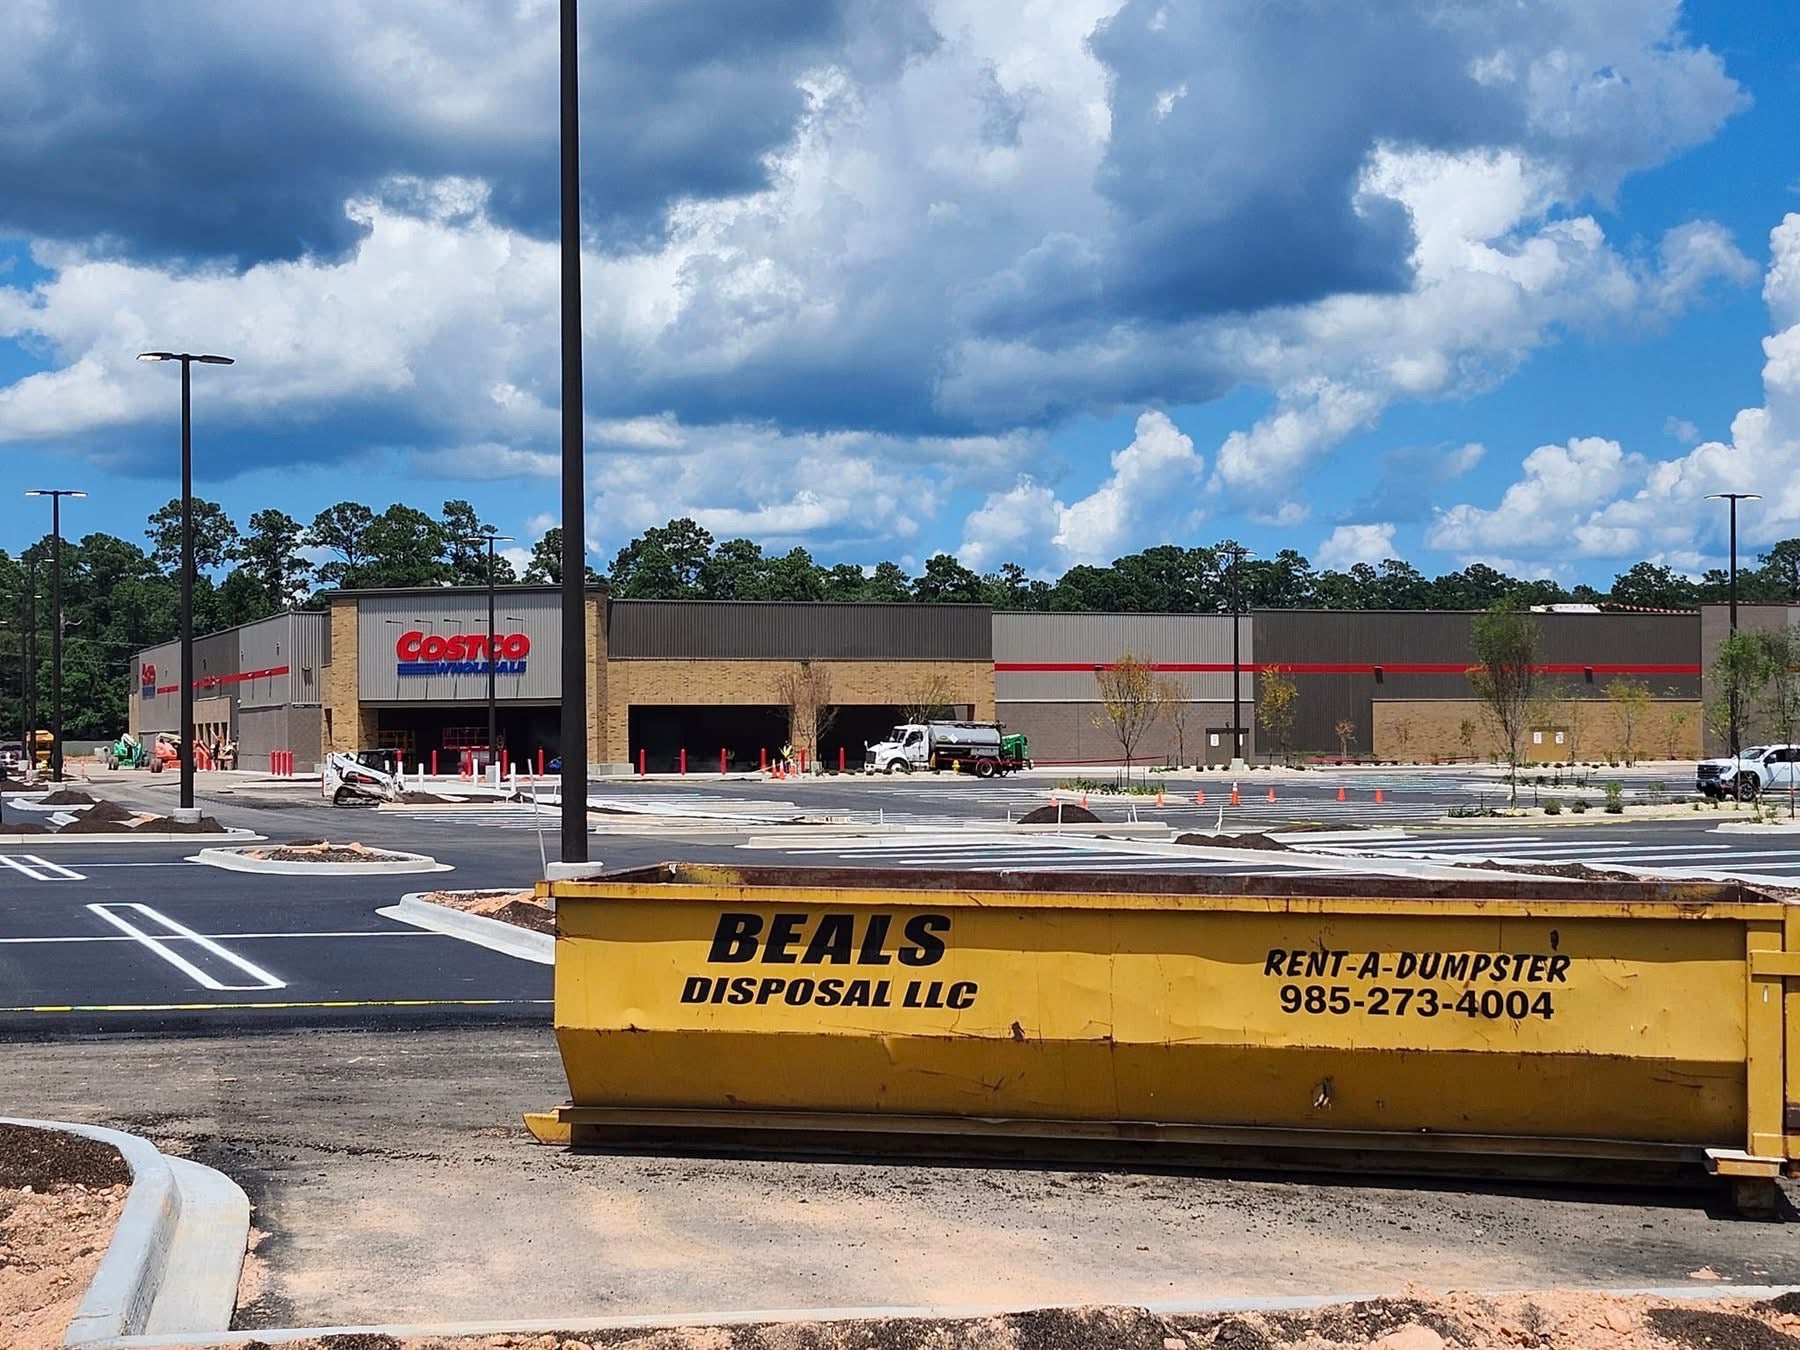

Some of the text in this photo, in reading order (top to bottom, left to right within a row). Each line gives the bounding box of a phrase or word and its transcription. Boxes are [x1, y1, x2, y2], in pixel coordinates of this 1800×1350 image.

[396, 630, 531, 661] COSTCO
[435, 661, 527, 674] WHOLEALE
[706, 912, 952, 967] BEALS
[1263, 948, 1571, 983] RENT-A-DUMPSTER
[680, 977, 978, 1010] DISPOSAL LLC
[1280, 984, 1555, 1020] 985-273-4004
